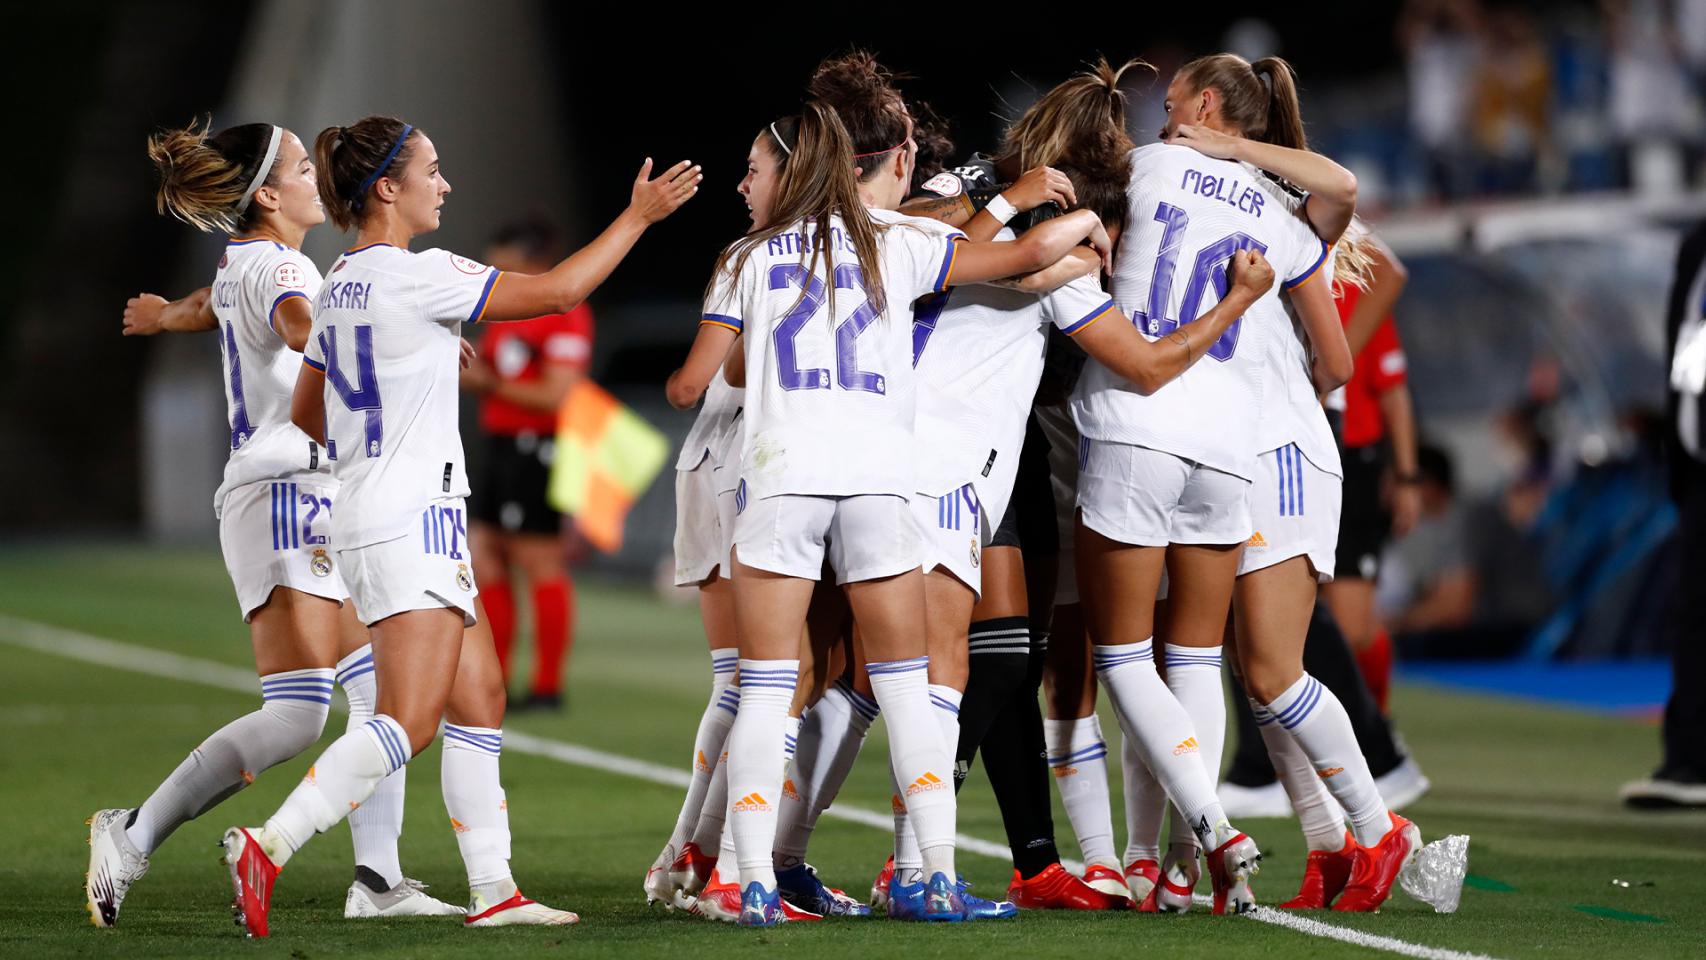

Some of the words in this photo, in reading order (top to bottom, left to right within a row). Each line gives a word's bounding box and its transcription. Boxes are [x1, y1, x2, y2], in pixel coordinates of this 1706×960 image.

[1181, 168, 1265, 218] MØLLER
[1132, 201, 1269, 363] 10
[767, 262, 887, 396] 22
[731, 804, 773, 814] adidas
[905, 781, 949, 797] adidas
